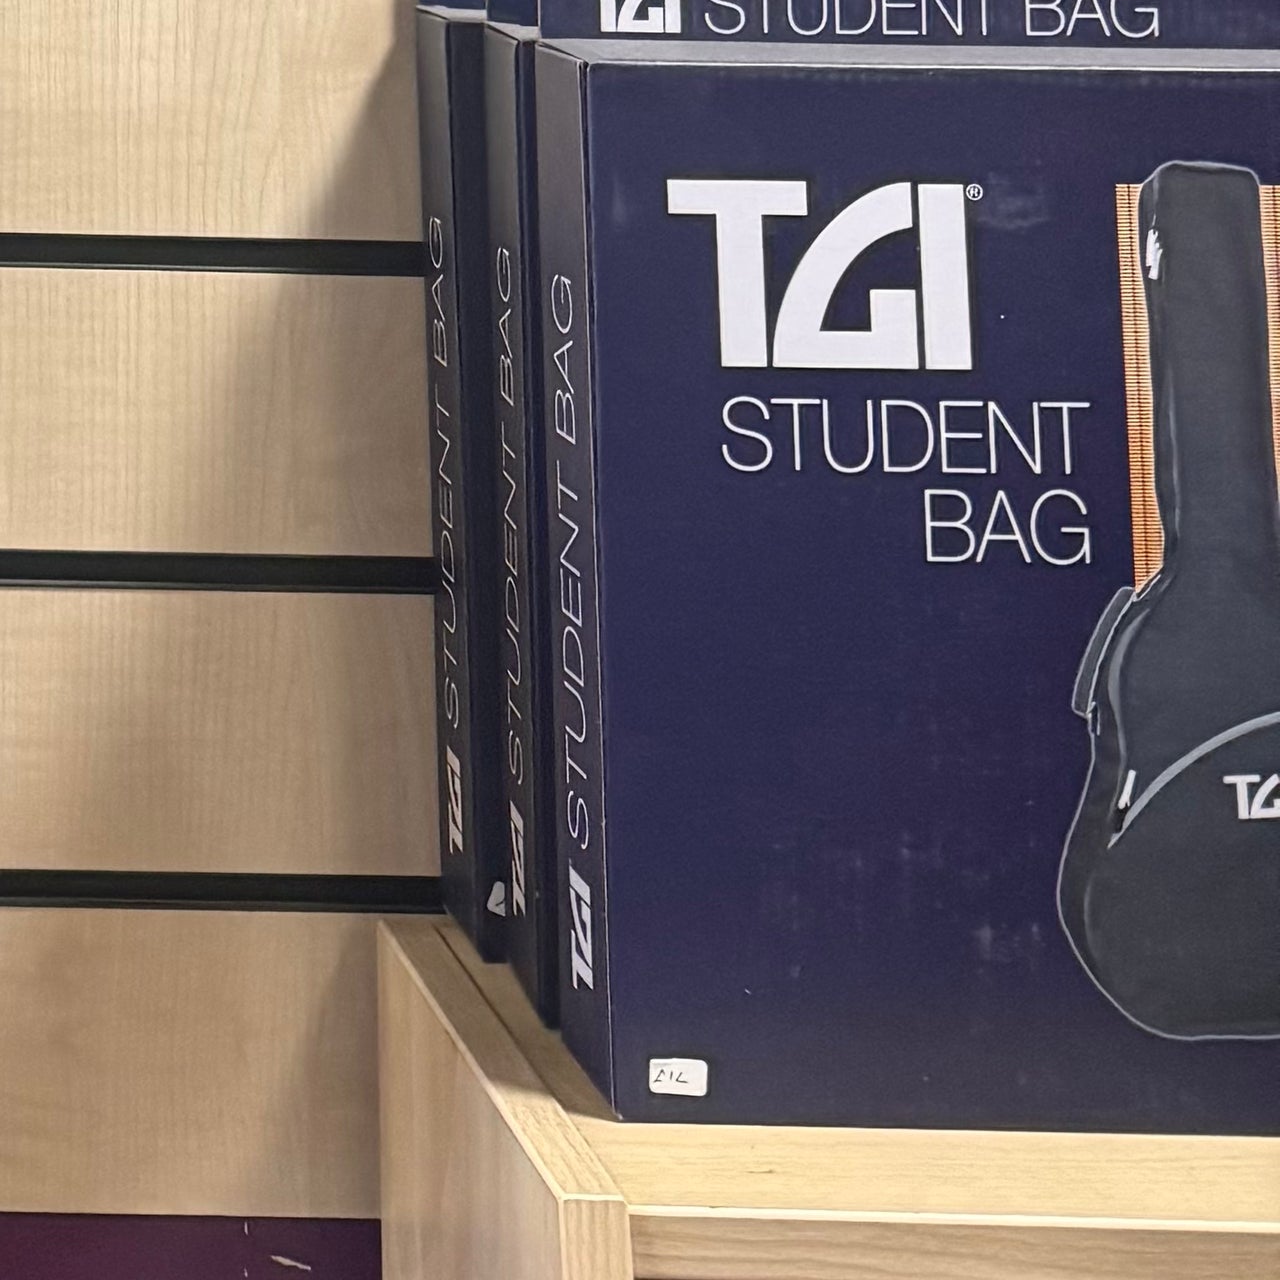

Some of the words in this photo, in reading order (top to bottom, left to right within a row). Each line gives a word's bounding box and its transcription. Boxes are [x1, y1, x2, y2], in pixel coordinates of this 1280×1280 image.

[429, 216, 447, 367] BAG
[496, 246, 514, 406] BAG
[667, 179, 972, 370] TGI
[551, 274, 576, 445] BAG
[721, 397, 1090, 474] STUDENT
[435, 382, 460, 730] STUDENT
[502, 420, 523, 785] STUDENT
[926, 489, 1091, 564] BAG
[556, 460, 589, 851] STUDENT
[1223, 773, 1280, 819] TG
[569, 860, 594, 990] TGI
